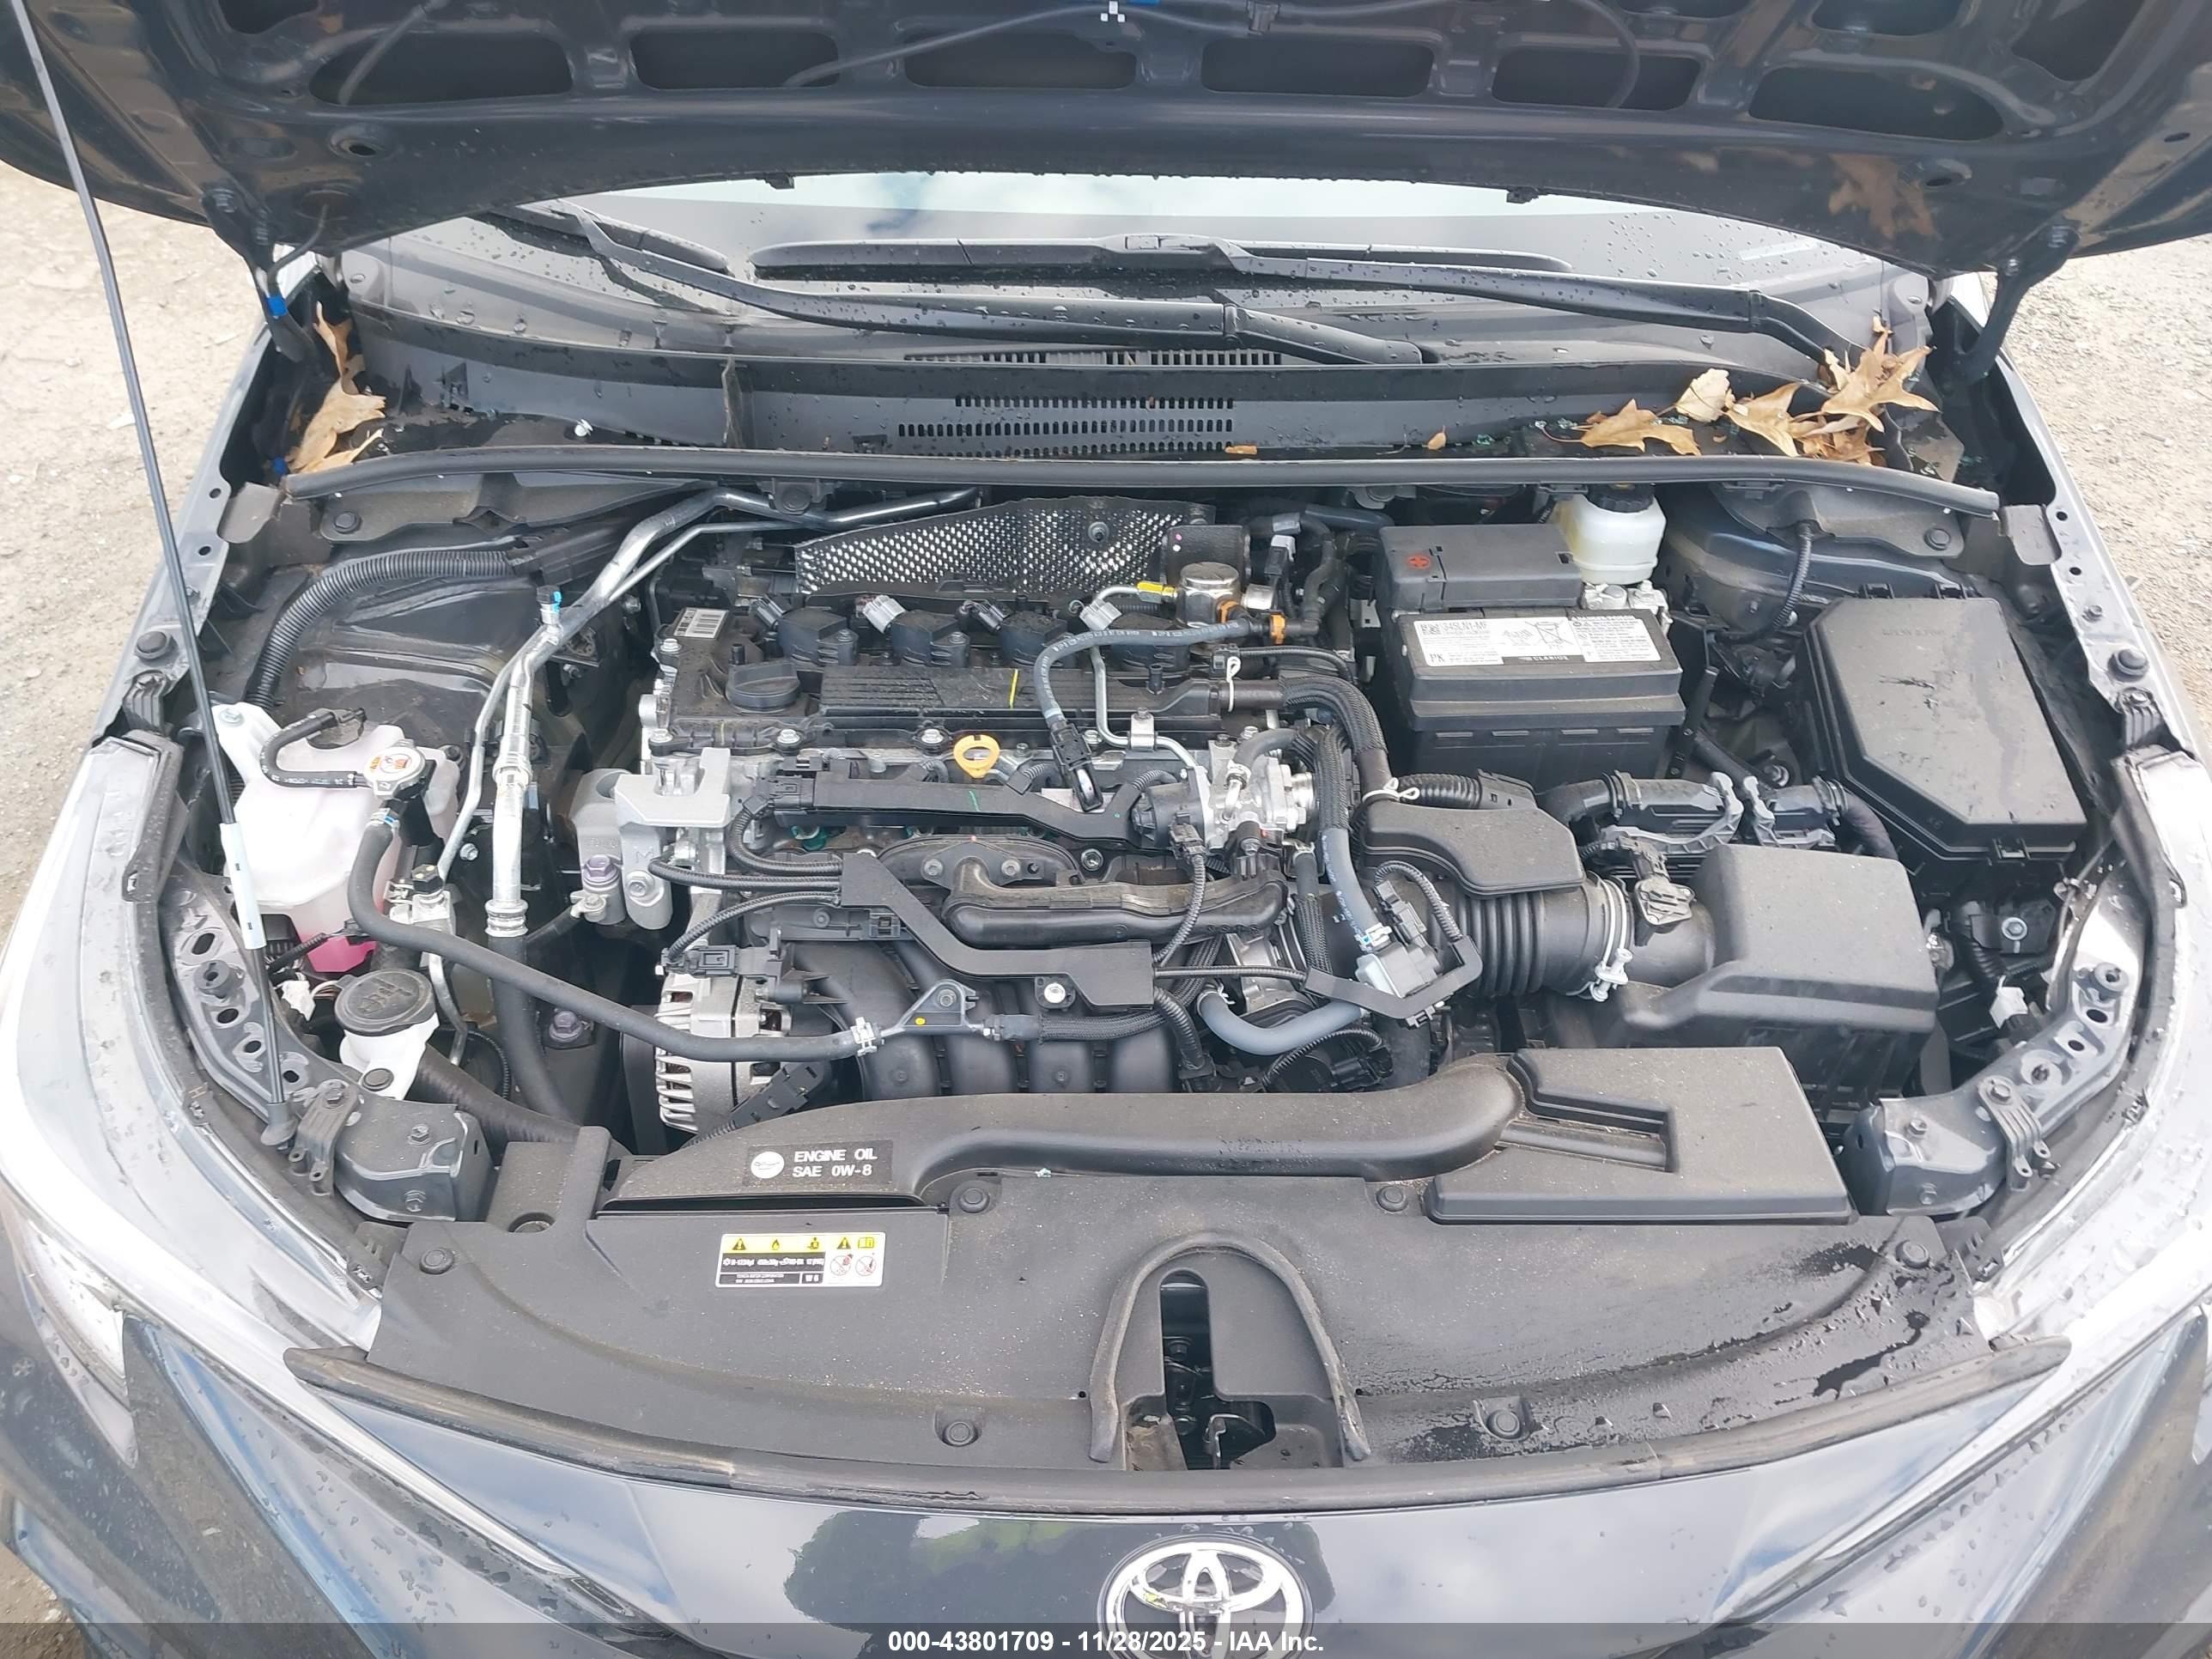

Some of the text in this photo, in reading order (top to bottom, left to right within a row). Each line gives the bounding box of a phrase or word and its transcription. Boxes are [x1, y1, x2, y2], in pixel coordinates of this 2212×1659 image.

[794, 1147, 878, 1162] ENGINE OIL
[792, 1164, 872, 1177] SAE 0W-8
